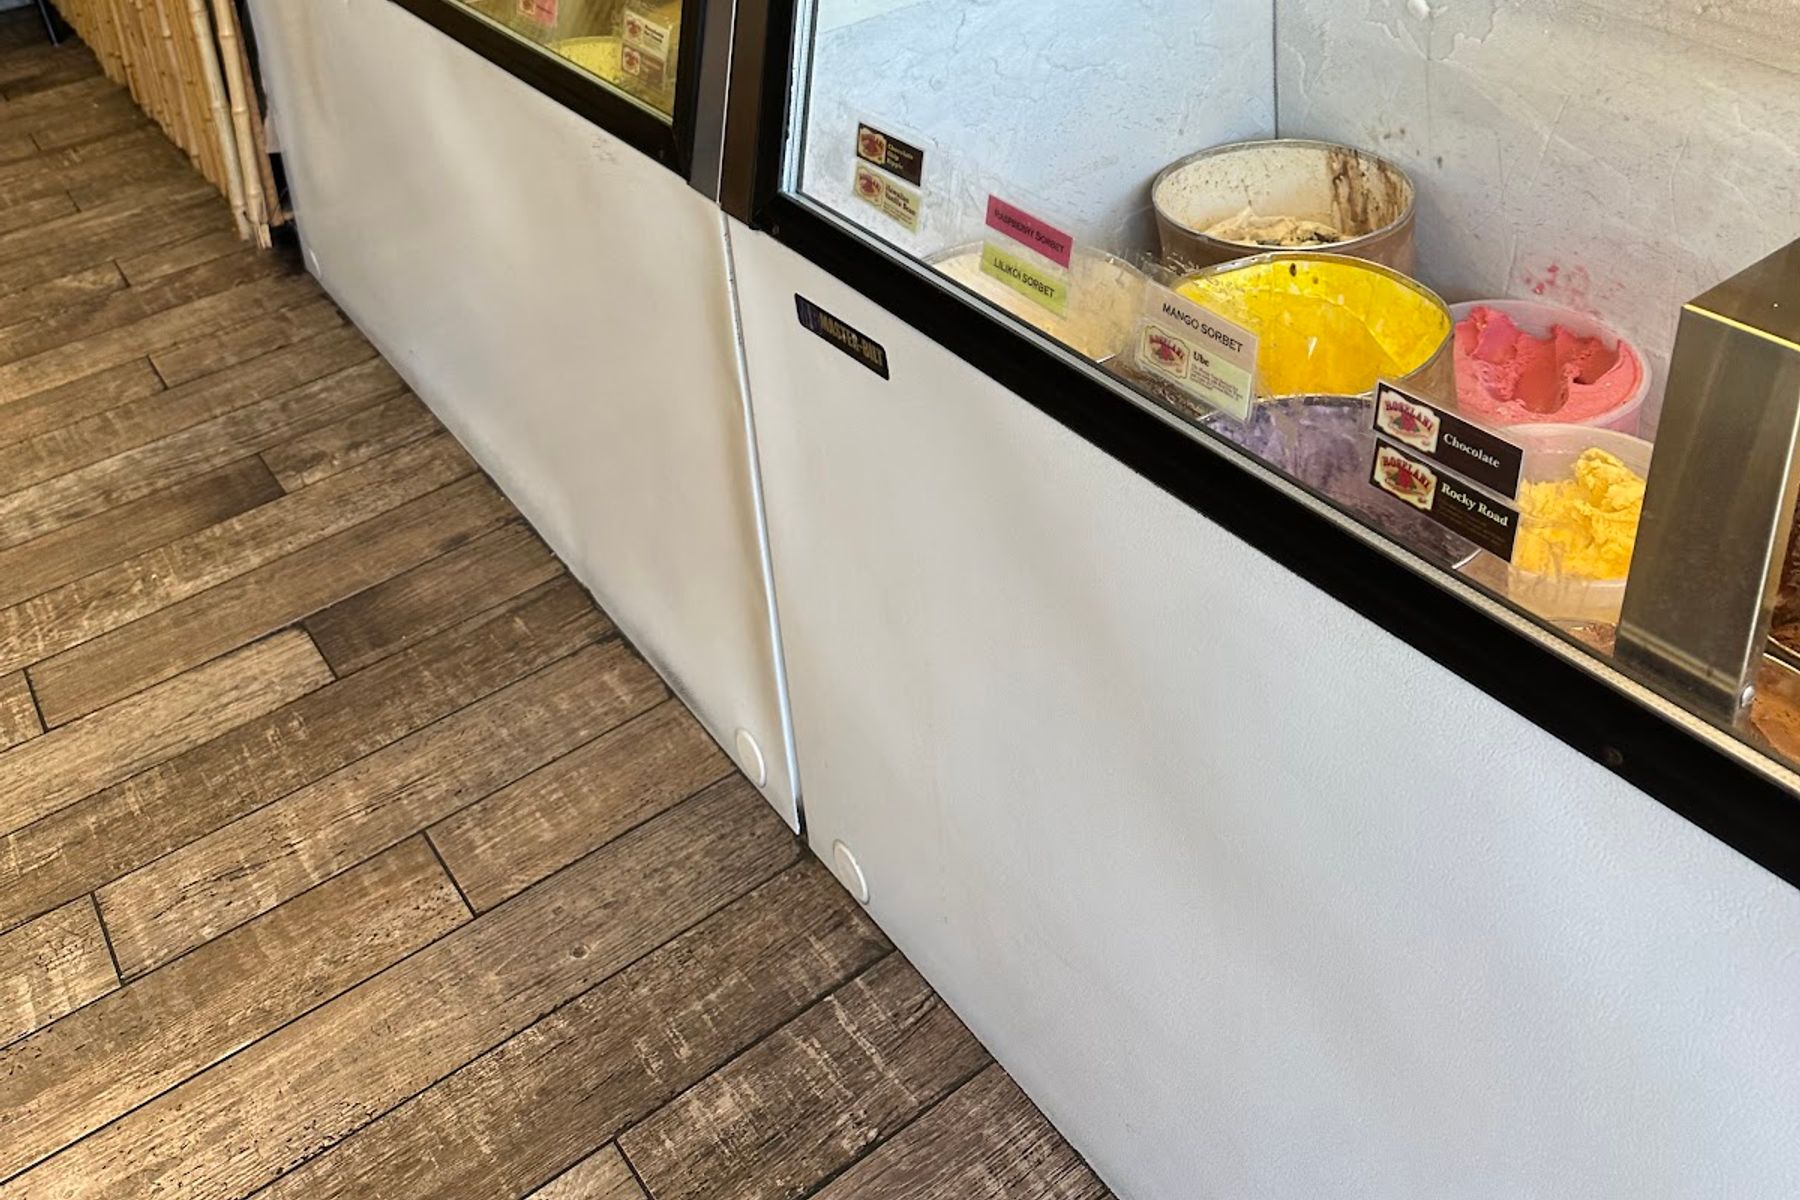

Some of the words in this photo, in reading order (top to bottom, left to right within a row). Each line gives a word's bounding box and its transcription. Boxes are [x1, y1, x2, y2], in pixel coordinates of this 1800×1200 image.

[1036, 230, 1065, 254] SORBET
[1022, 272, 1056, 299] SORBET
[1162, 302, 1200, 330] MANGO
[1201, 323, 1244, 353] SORBET
[1193, 350, 1211, 367] Ube
[1384, 400, 1434, 432] ROSELANI
[1443, 432, 1500, 469] Chocolate
[1381, 455, 1431, 489] ROSELANI
[1441, 482, 1477, 512] Rocky
[1478, 501, 1509, 528] Road
